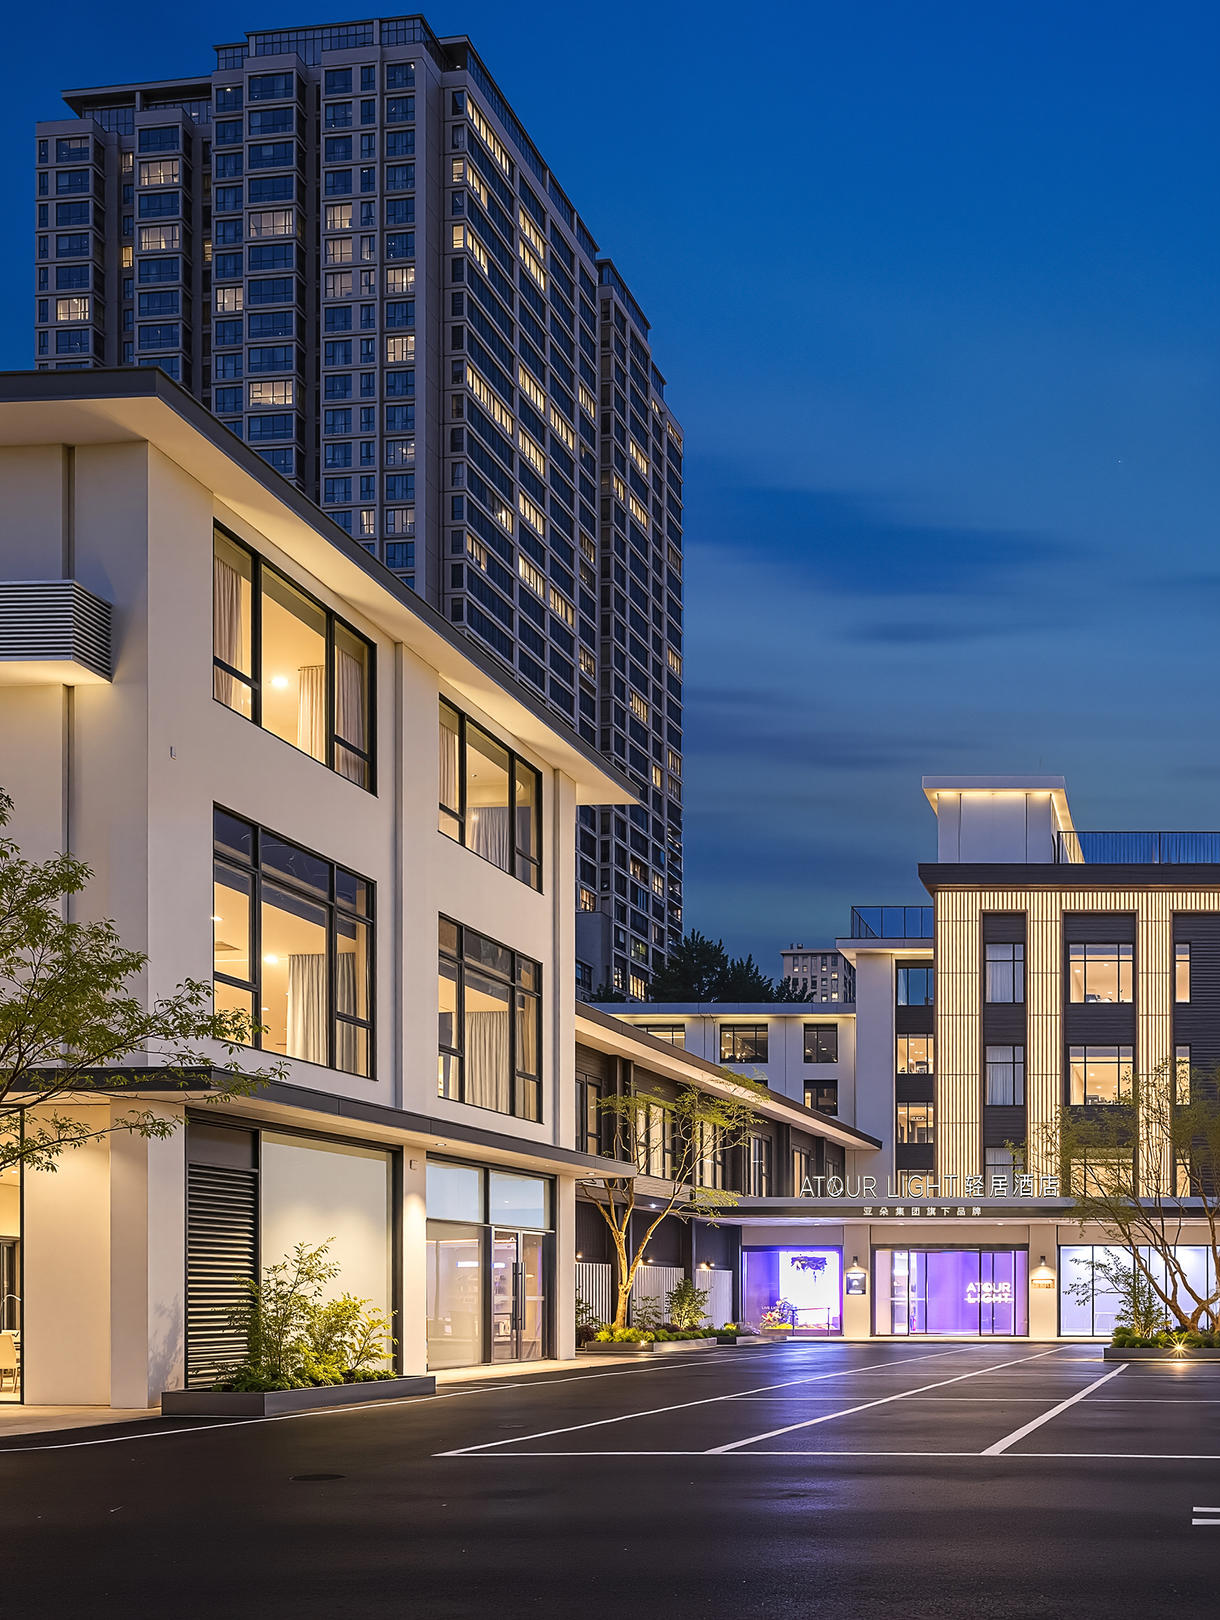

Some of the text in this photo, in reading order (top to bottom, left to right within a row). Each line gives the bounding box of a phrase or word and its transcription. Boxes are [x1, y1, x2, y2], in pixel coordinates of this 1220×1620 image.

[800, 1174, 1059, 1198] ATOUR LIGHT 轻居酒店
[863, 1206, 982, 1216] 亚朵集团旗下品牌
[966, 1282, 1011, 1293] ATOUR
[967, 1292, 1012, 1304] LIGHT
